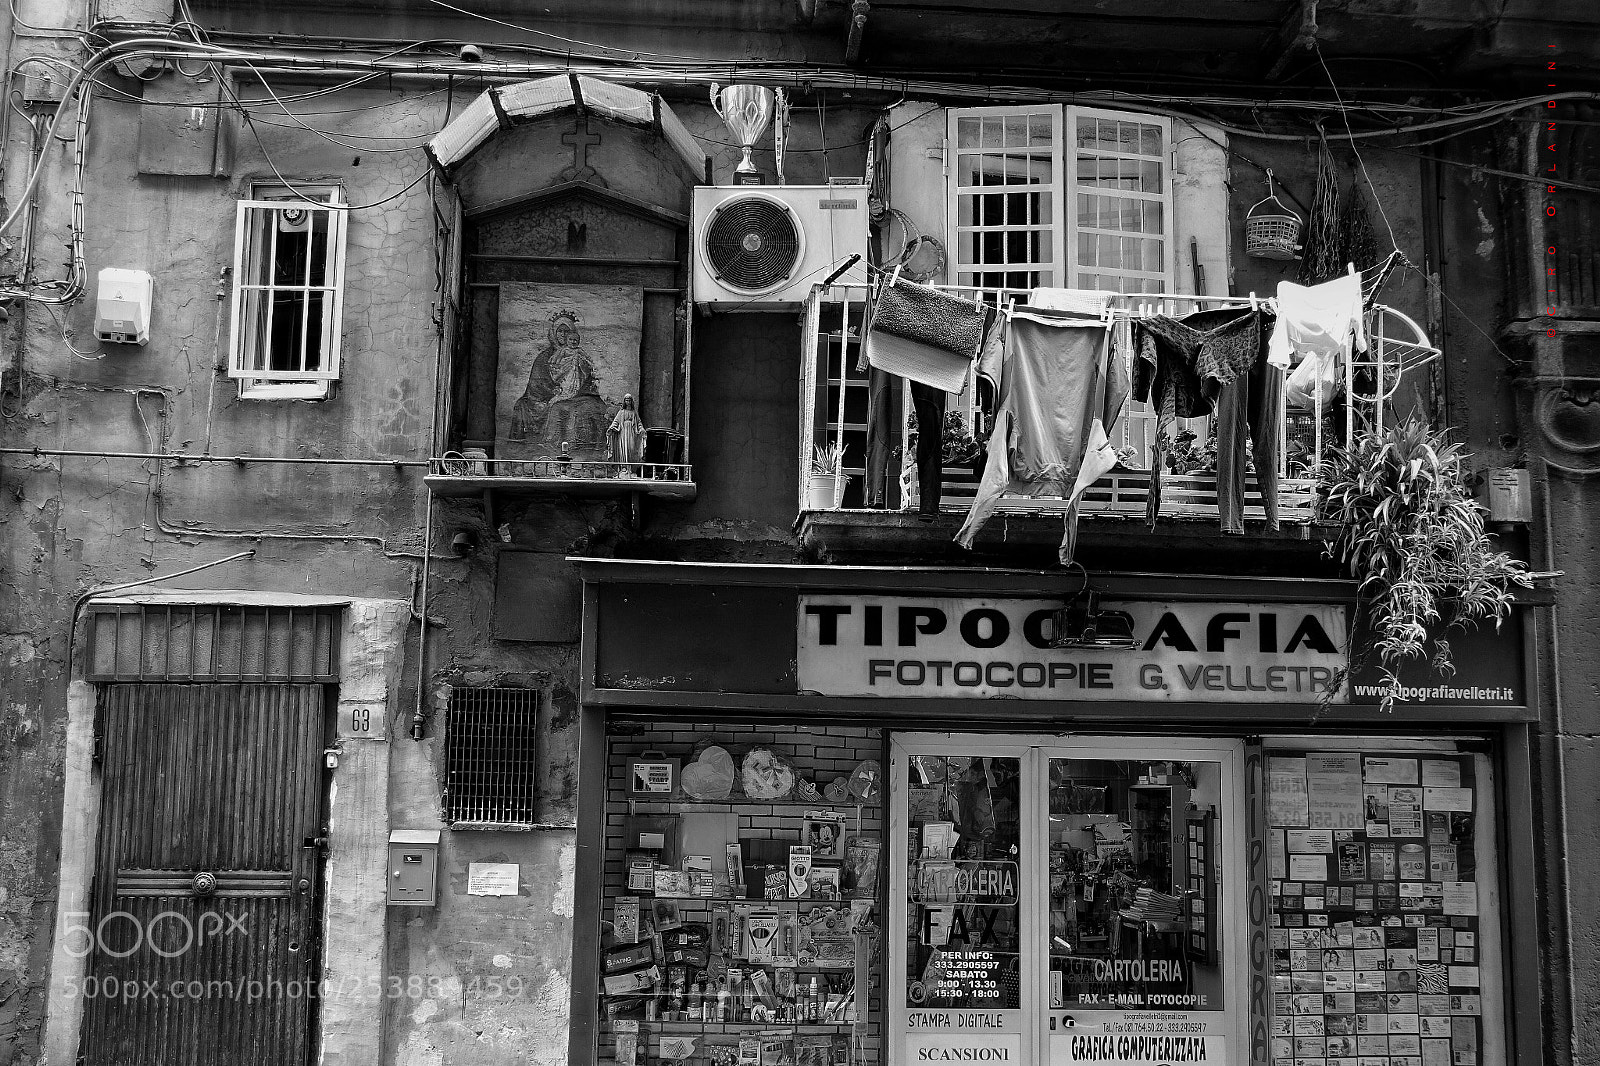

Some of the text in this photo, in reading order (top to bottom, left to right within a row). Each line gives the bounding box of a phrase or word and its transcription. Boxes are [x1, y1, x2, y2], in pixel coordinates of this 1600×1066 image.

[805, 604, 1339, 653] TIPOGAFIA
[868, 659, 1340, 693] FOTOCOPIE G. VELLETR
[1354, 684, 1514, 702] wwwtipografiavelletri.it
[352, 709, 370, 732] 63
[923, 908, 1001, 945] FAX
[941, 951, 993, 960] PER INFO:
[934, 961, 1000, 970] 333.2905597
[1094, 959, 1183, 982] CARTOLERIA
[946, 970, 988, 979] SABATO
[937, 980, 960, 989] 9:00
[968, 980, 997, 989] 13.30
[934, 989, 963, 998] 15:30
[971, 989, 1000, 998] 18:00
[1078, 993, 1099, 1004] FAX
[1108, 994, 1145, 1005] E-MAIL
[1147, 994, 1208, 1006] FOTOCOPIE
[908, 1013, 1003, 1028] STAMPA DIGITALE
[918, 1047, 1010, 1061] SCANSIONI
[1071, 1035, 1206, 1062] GRAFICA COMPUTERIZZATA
